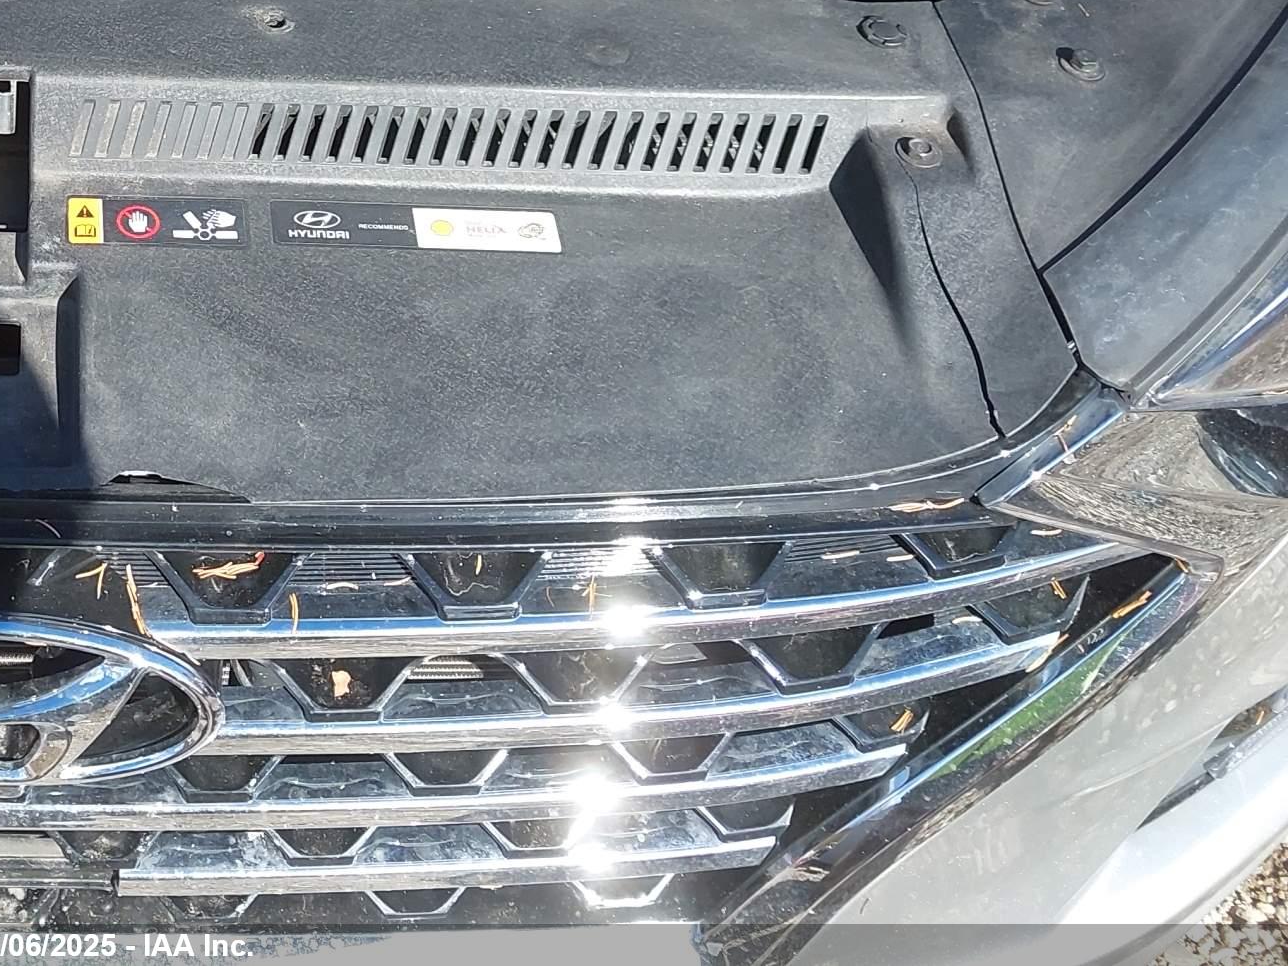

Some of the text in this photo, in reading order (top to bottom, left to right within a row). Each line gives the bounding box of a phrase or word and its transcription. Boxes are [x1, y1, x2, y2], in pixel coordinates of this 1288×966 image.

[358, 223, 409, 231] RECOMMENDS
[465, 225, 508, 234] HELIX
[288, 229, 350, 240] HYUNDAI
